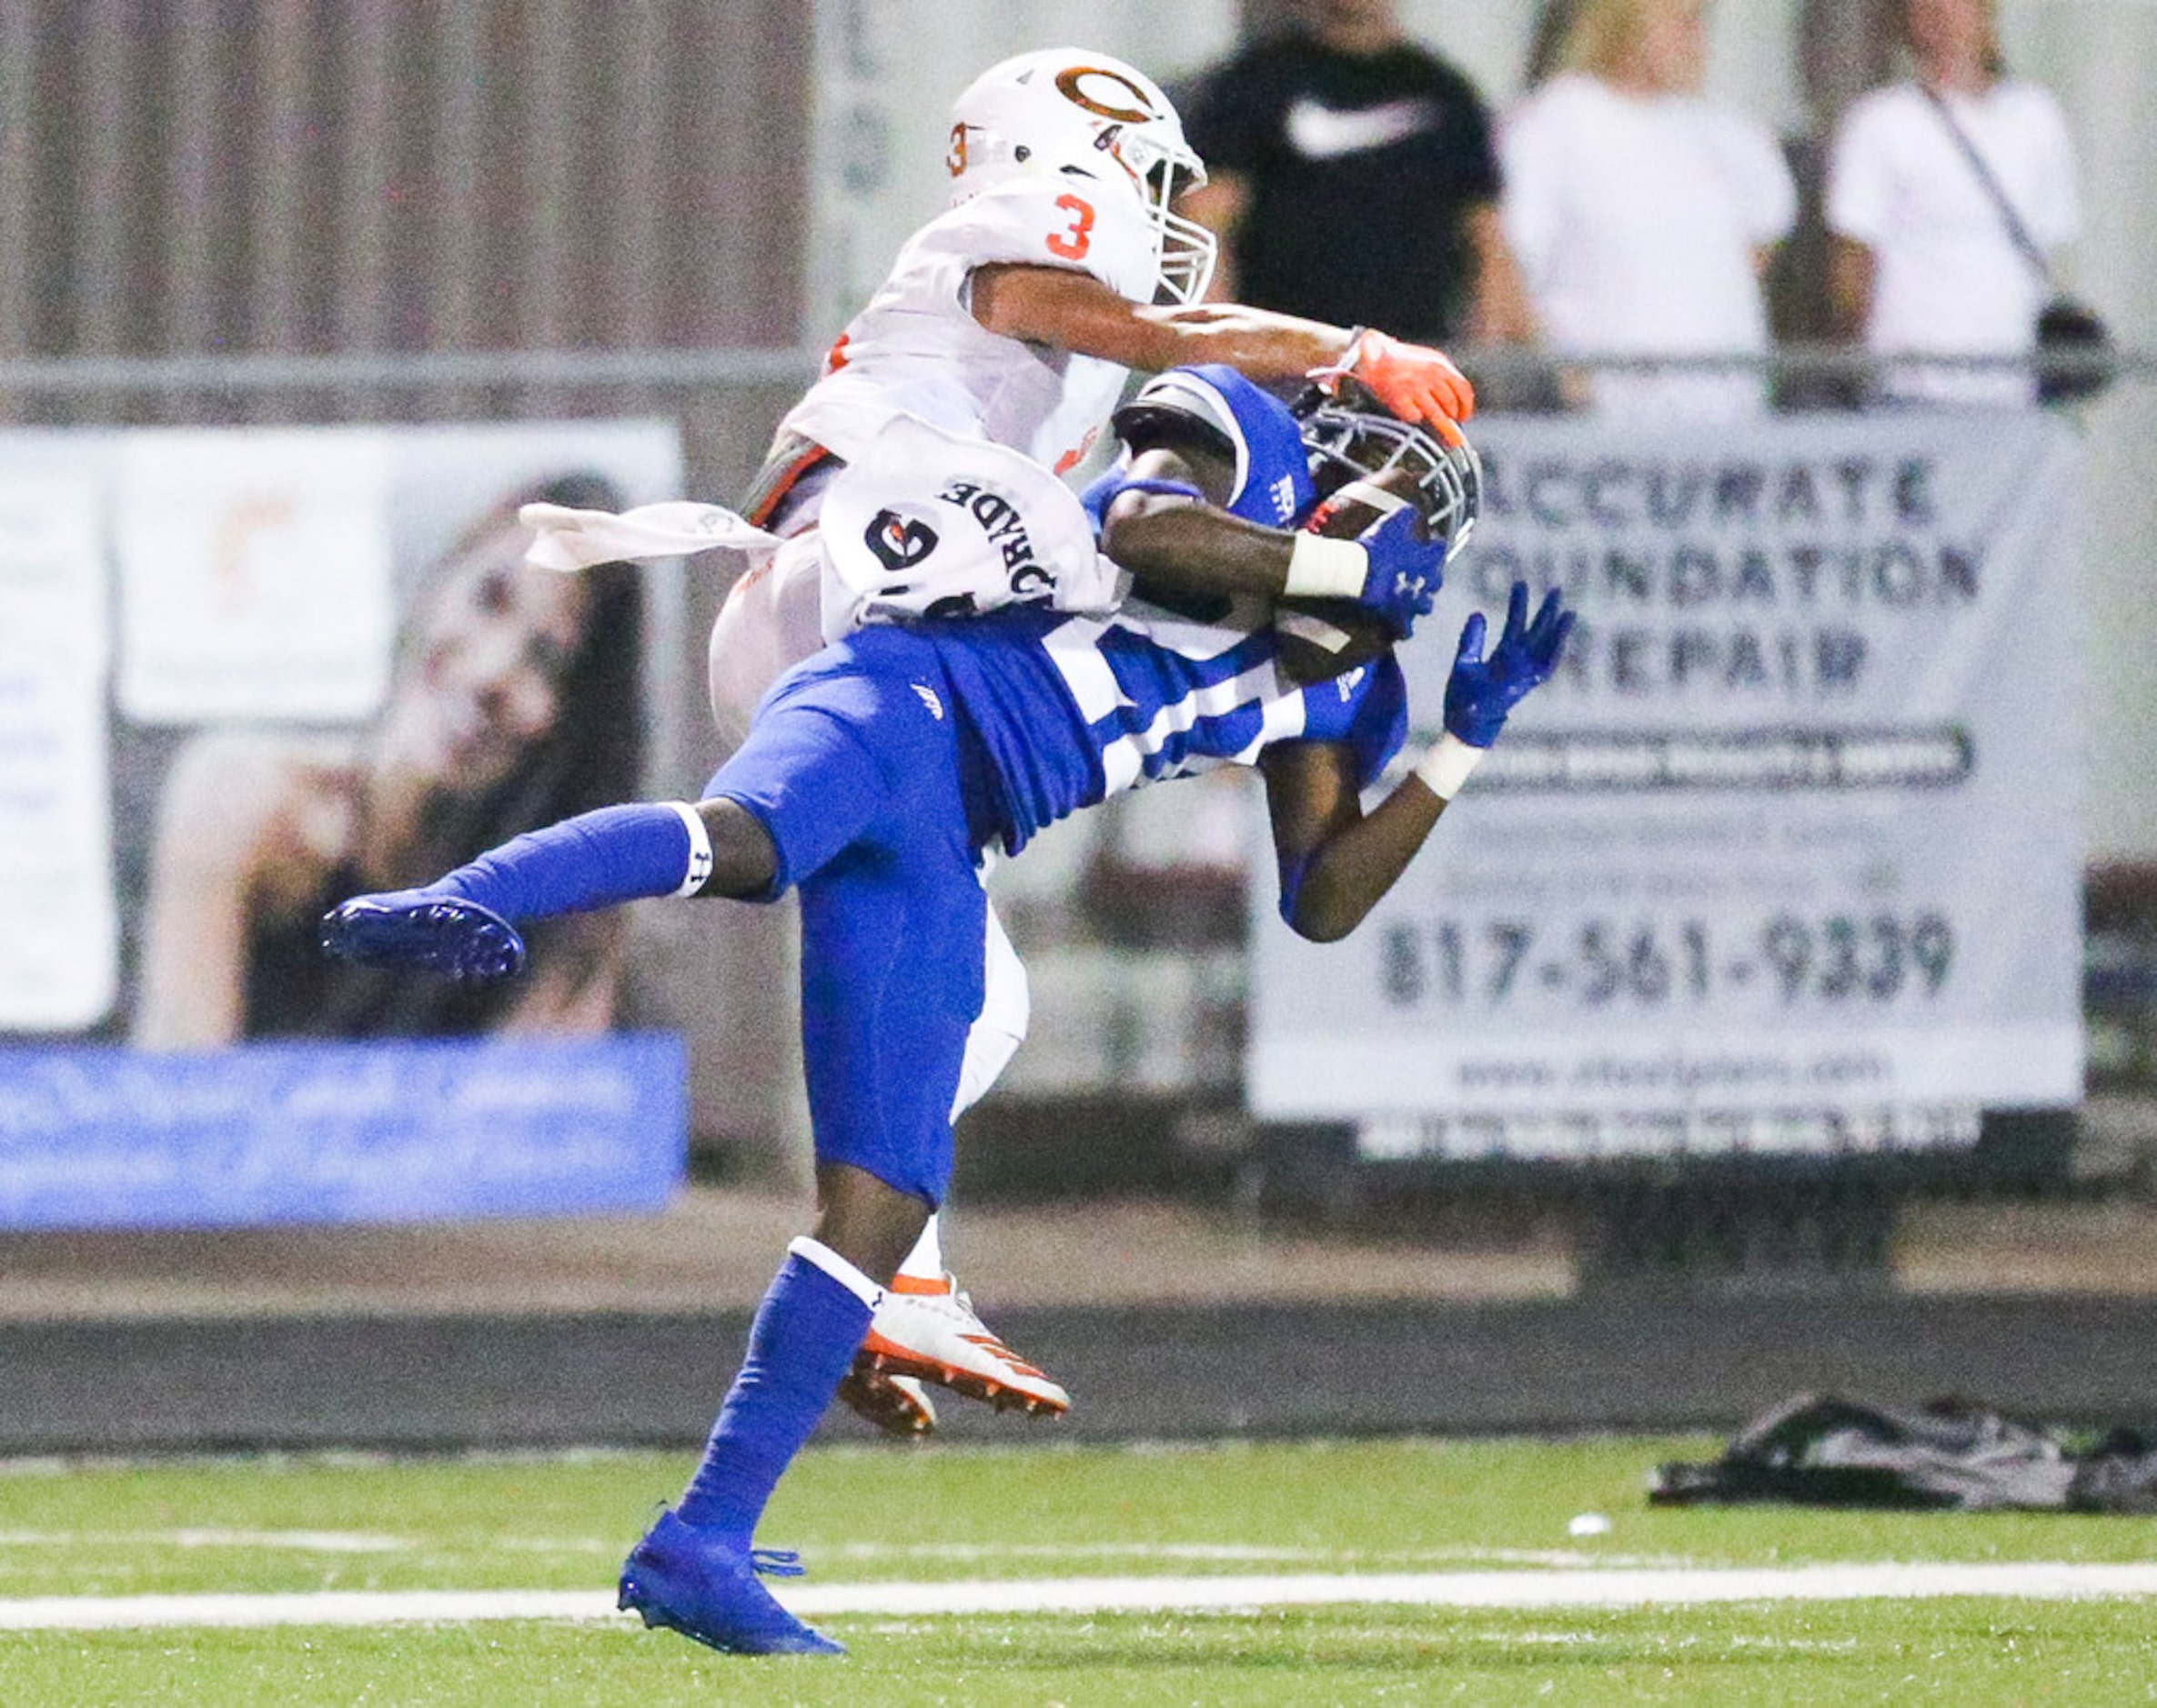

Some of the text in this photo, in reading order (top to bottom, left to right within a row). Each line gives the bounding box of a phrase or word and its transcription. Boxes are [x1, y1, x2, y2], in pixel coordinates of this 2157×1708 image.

[1056, 66, 1164, 123] C
[946, 121, 967, 177] 3
[1046, 194, 1094, 261] 3
[937, 481, 1057, 603] ORADE
[1469, 543, 1983, 608] OUNDATION
